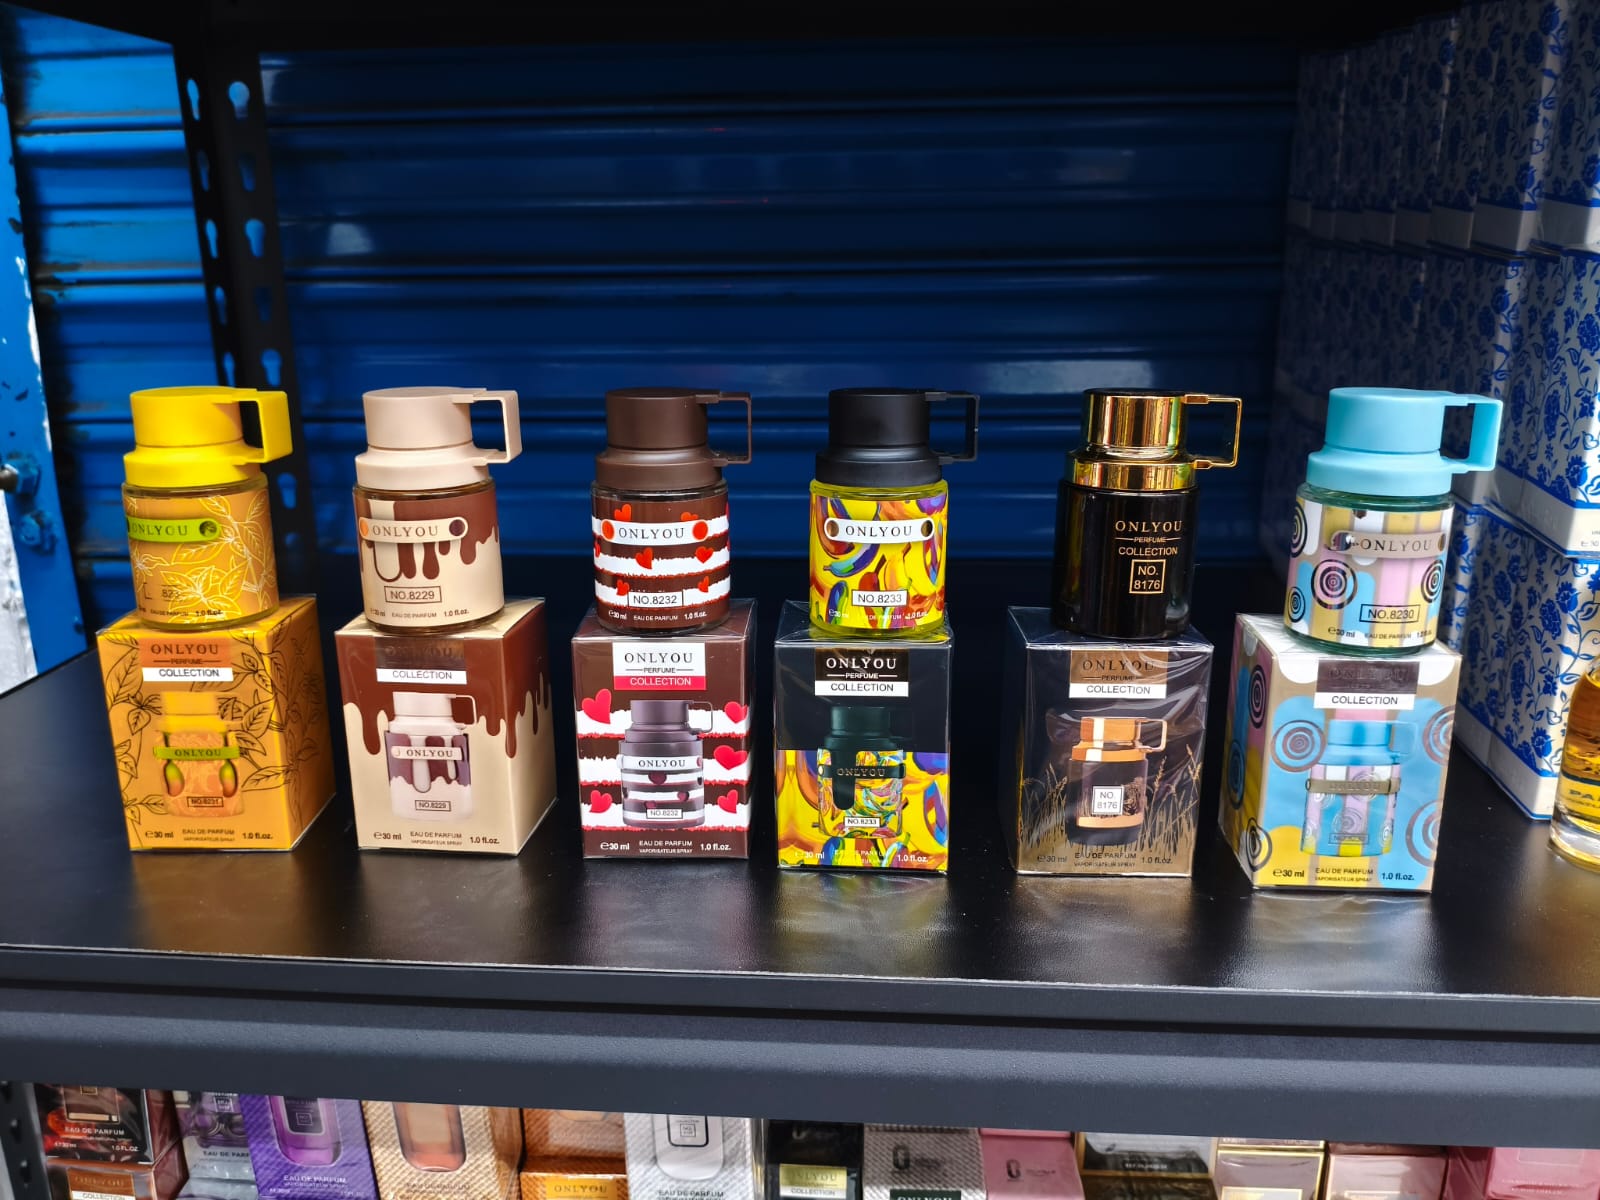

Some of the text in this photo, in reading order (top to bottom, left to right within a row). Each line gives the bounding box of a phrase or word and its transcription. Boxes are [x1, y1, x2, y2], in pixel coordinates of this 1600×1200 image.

[131, 524, 188, 536] ONLYOU
[372, 525, 438, 537] ONLYOU
[1115, 520, 1182, 532] ONLYOU
[618, 527, 685, 540] ONLYOU
[845, 526, 912, 537] ONLYOU
[1360, 538, 1432, 551] ONLYOU
[1118, 546, 1178, 556] COLLECTION
[1137, 565, 1159, 576] NO.
[1134, 579, 1160, 590] 8176
[390, 590, 435, 600] NO.8229
[633, 595, 678, 605] NO.8232
[858, 594, 902, 604] NO.8233
[1368, 608, 1414, 619] NO.8230
[150, 644, 219, 654] ONLYOU
[624, 652, 693, 664] ONLYOU
[826, 658, 897, 669] ONLYOU
[1082, 659, 1154, 671] ONLYOU
[158, 669, 220, 678] COLLECTION
[392, 670, 453, 680] COLLECTION
[630, 677, 692, 686] COLLECTION
[830, 683, 894, 692] COLLECTION
[1086, 685, 1151, 694] COLLECTION
[1331, 696, 1398, 705] COLLECTION
[406, 750, 454, 758] ONLYOU
[638, 760, 686, 768] ONLYOU
[836, 768, 886, 776] ONLYOU
[242, 832, 253, 840] 1.0
[620, 842, 630, 850] ml
[815, 851, 825, 859] ml
[897, 854, 908, 862] 1.0
[1142, 856, 1152, 864] 1.0
[1294, 870, 1305, 878] ml
[94, 1128, 125, 1136] PARFUM
[554, 1184, 607, 1193] ONLYOU
